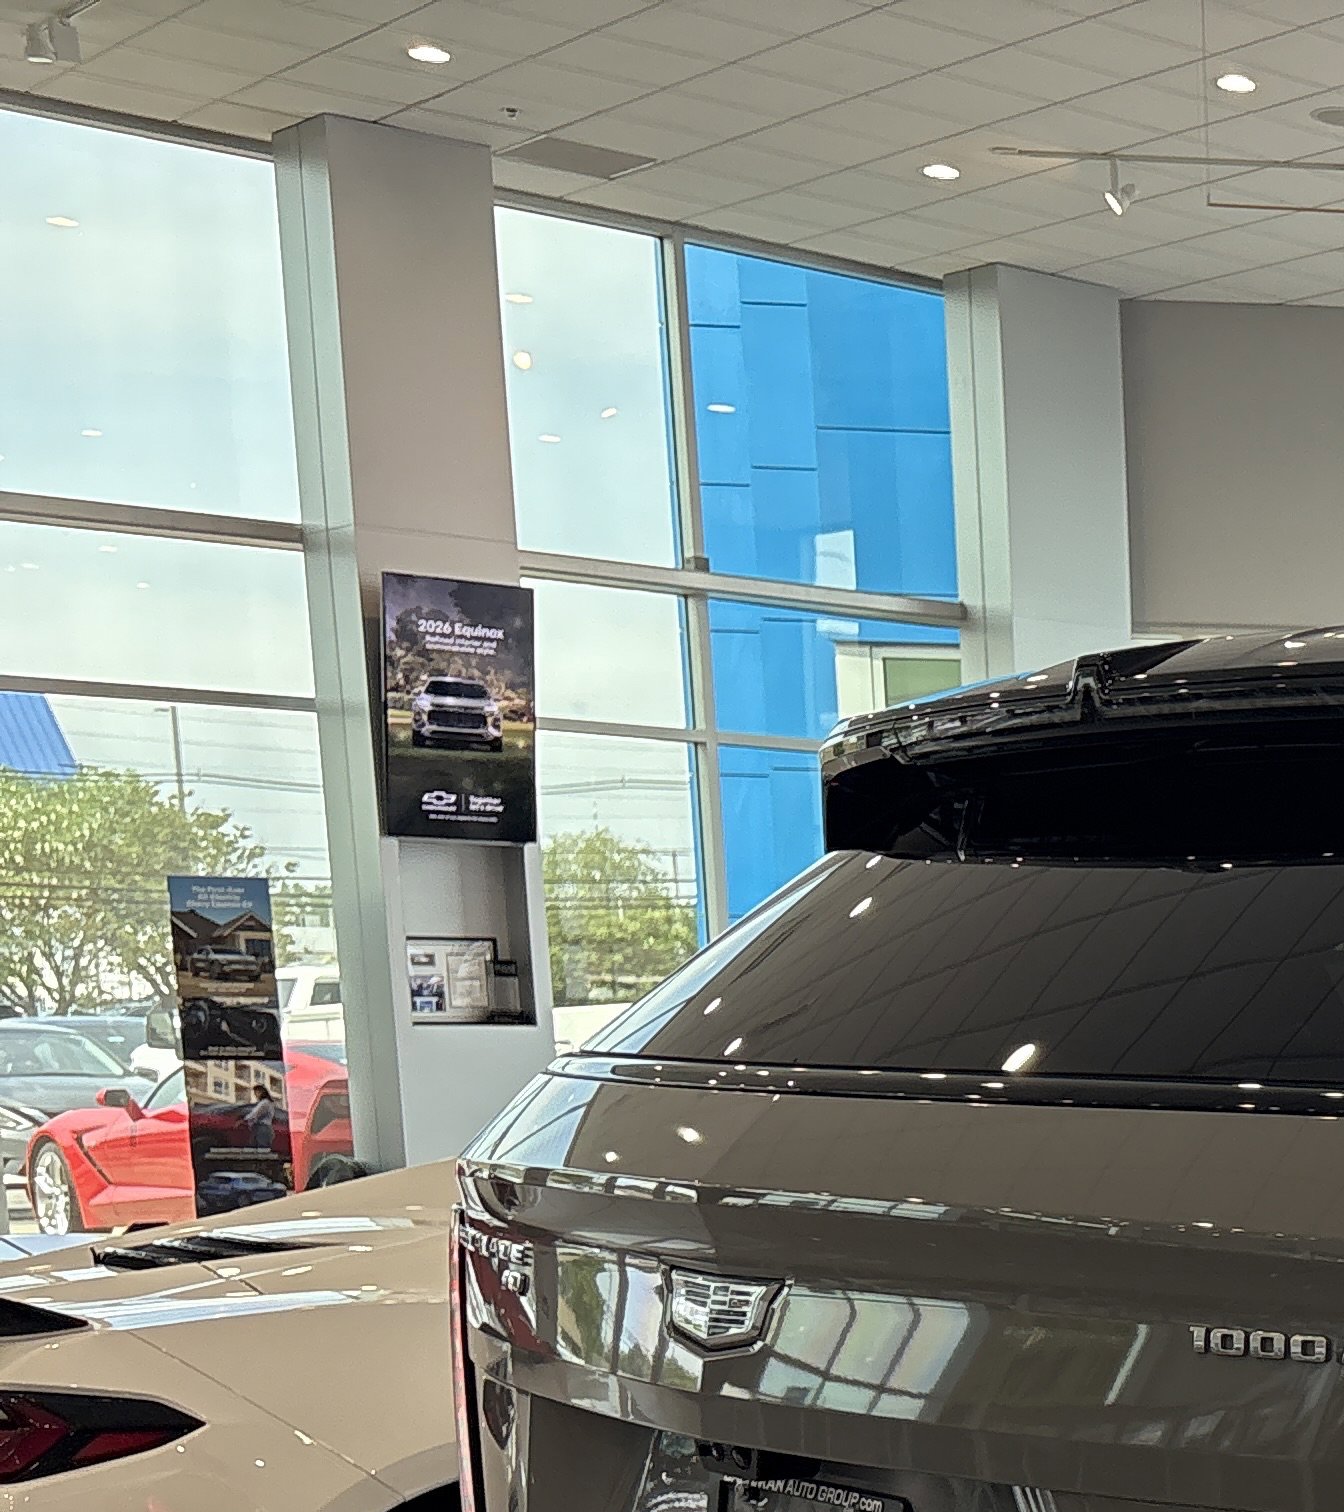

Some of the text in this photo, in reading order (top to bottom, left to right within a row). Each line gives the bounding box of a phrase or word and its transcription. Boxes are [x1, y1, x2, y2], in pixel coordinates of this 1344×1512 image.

[417, 618, 504, 640] 2026 Equinox
[1188, 1324, 1328, 1363] 1000
[784, 1479, 818, 1499] AUTO
